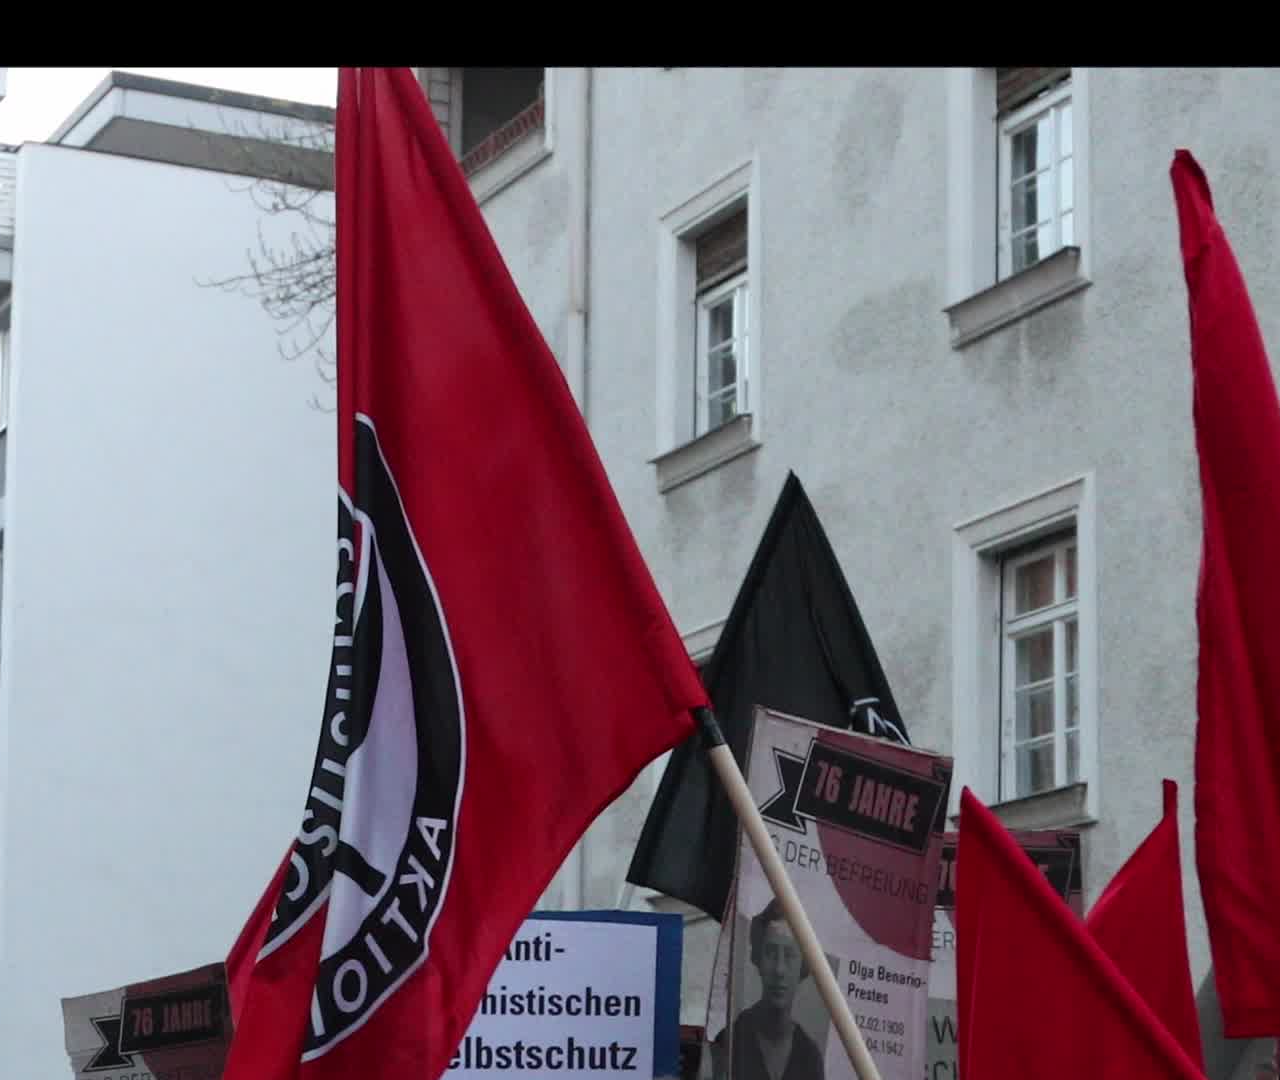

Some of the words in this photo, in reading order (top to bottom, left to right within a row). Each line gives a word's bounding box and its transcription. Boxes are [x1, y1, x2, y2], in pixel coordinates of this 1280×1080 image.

[814, 760, 843, 804] 76
[848, 775, 920, 833] JAHRE
[784, 840, 821, 874] DER
[848, 959, 875, 980] Olga
[847, 982, 889, 1005] Prestes
